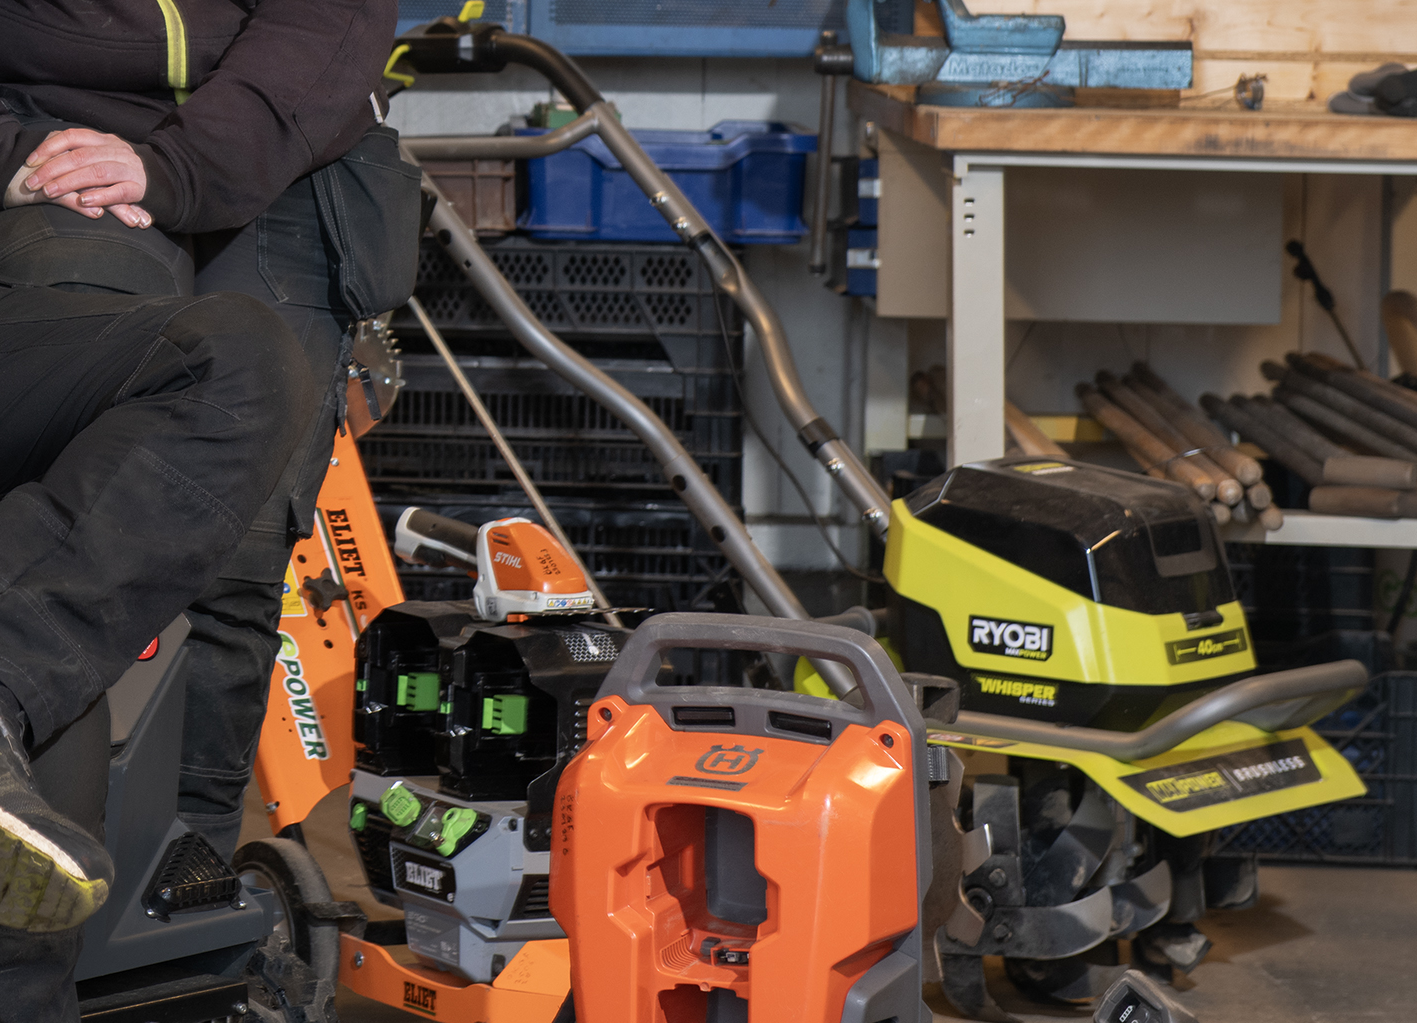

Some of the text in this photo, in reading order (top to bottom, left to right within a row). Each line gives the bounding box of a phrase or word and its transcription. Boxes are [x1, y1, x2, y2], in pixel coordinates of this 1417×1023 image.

[326, 509, 366, 577] ELIET
[494, 552, 522, 569] STIHL
[351, 590, 367, 610] KS
[972, 619, 1048, 652] RYOBI
[975, 677, 1056, 700] WHISPER
[1233, 755, 1306, 782] BRUSHLESS
[405, 861, 444, 891] ELIET
[404, 981, 437, 1011] ELIET
